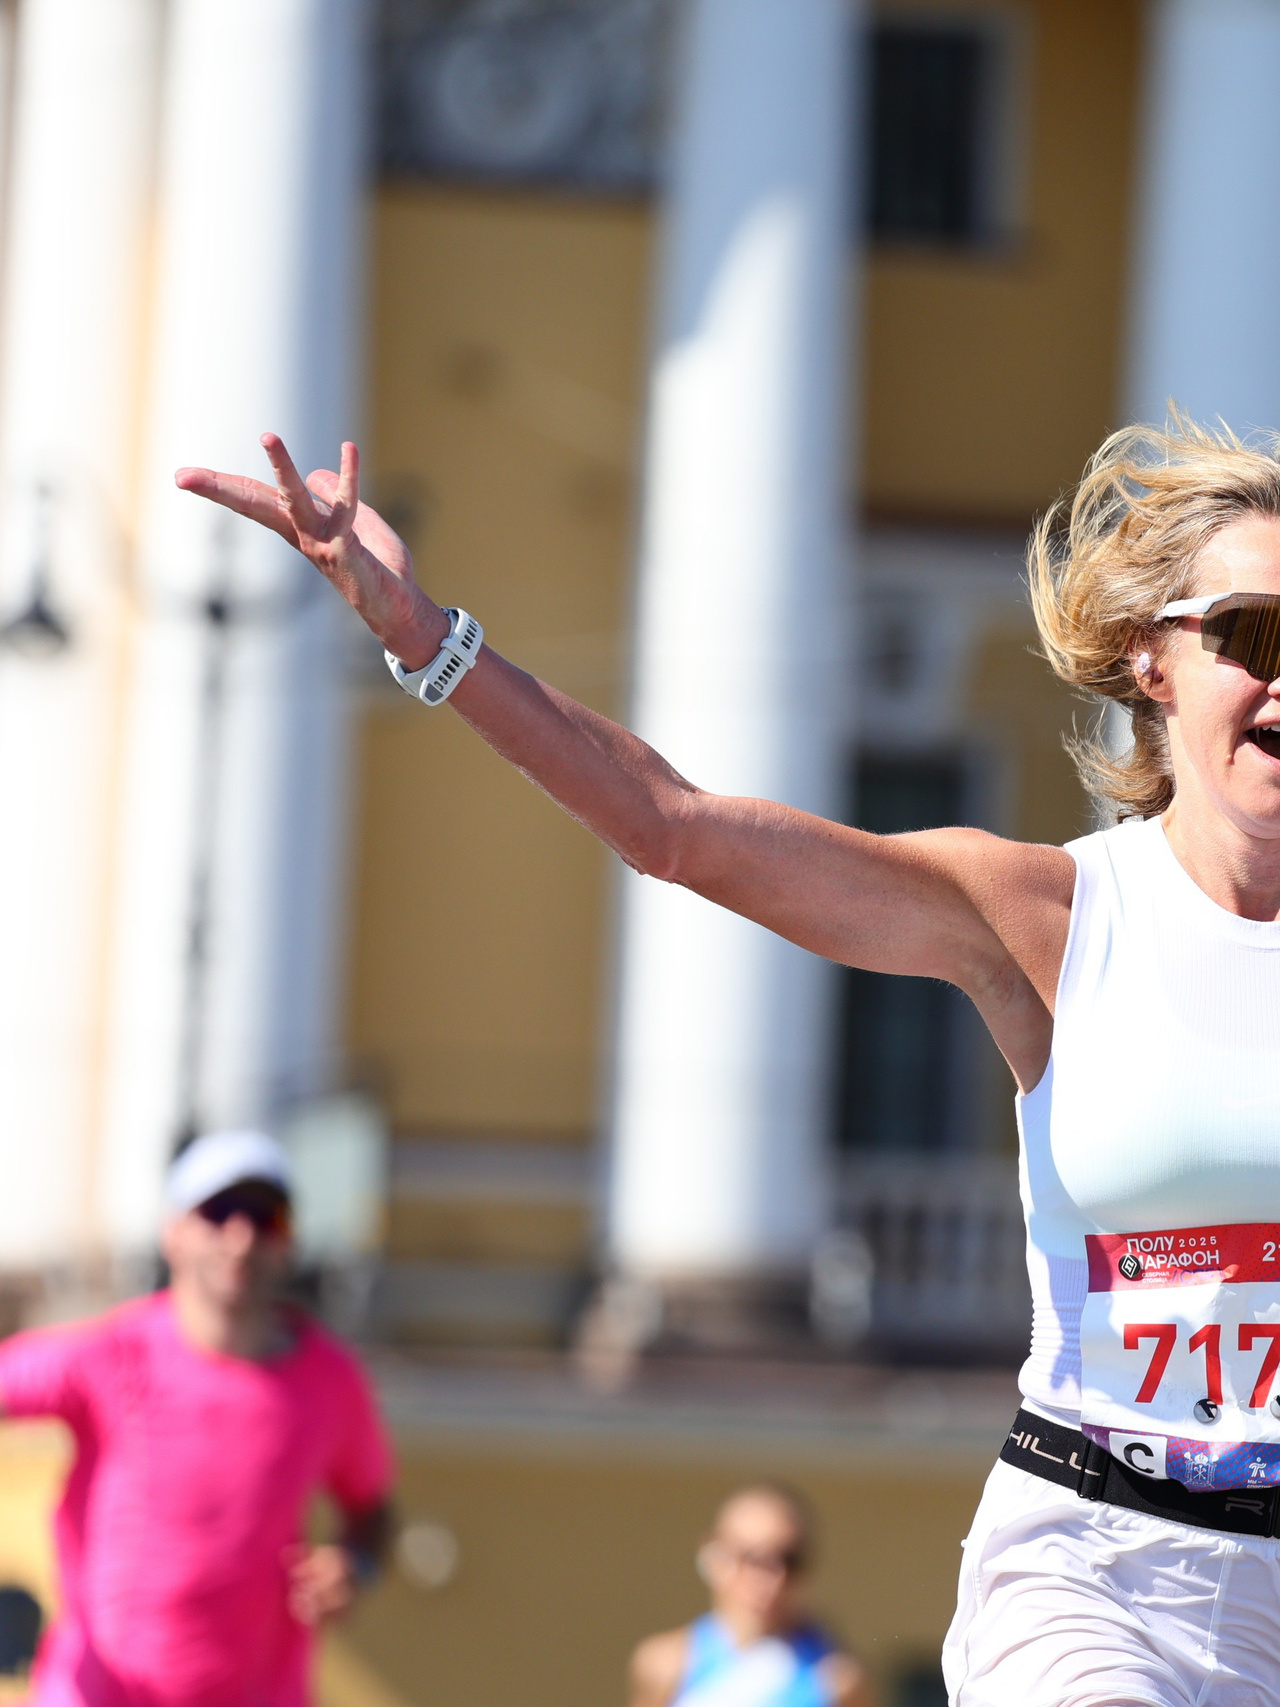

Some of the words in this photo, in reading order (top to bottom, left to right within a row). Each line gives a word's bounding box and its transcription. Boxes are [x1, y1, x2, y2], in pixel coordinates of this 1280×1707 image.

[1127, 1236, 1174, 1252] ПОЛУ
[1179, 1236, 1217, 1247] 2025
[1123, 1442, 1154, 1474] C
